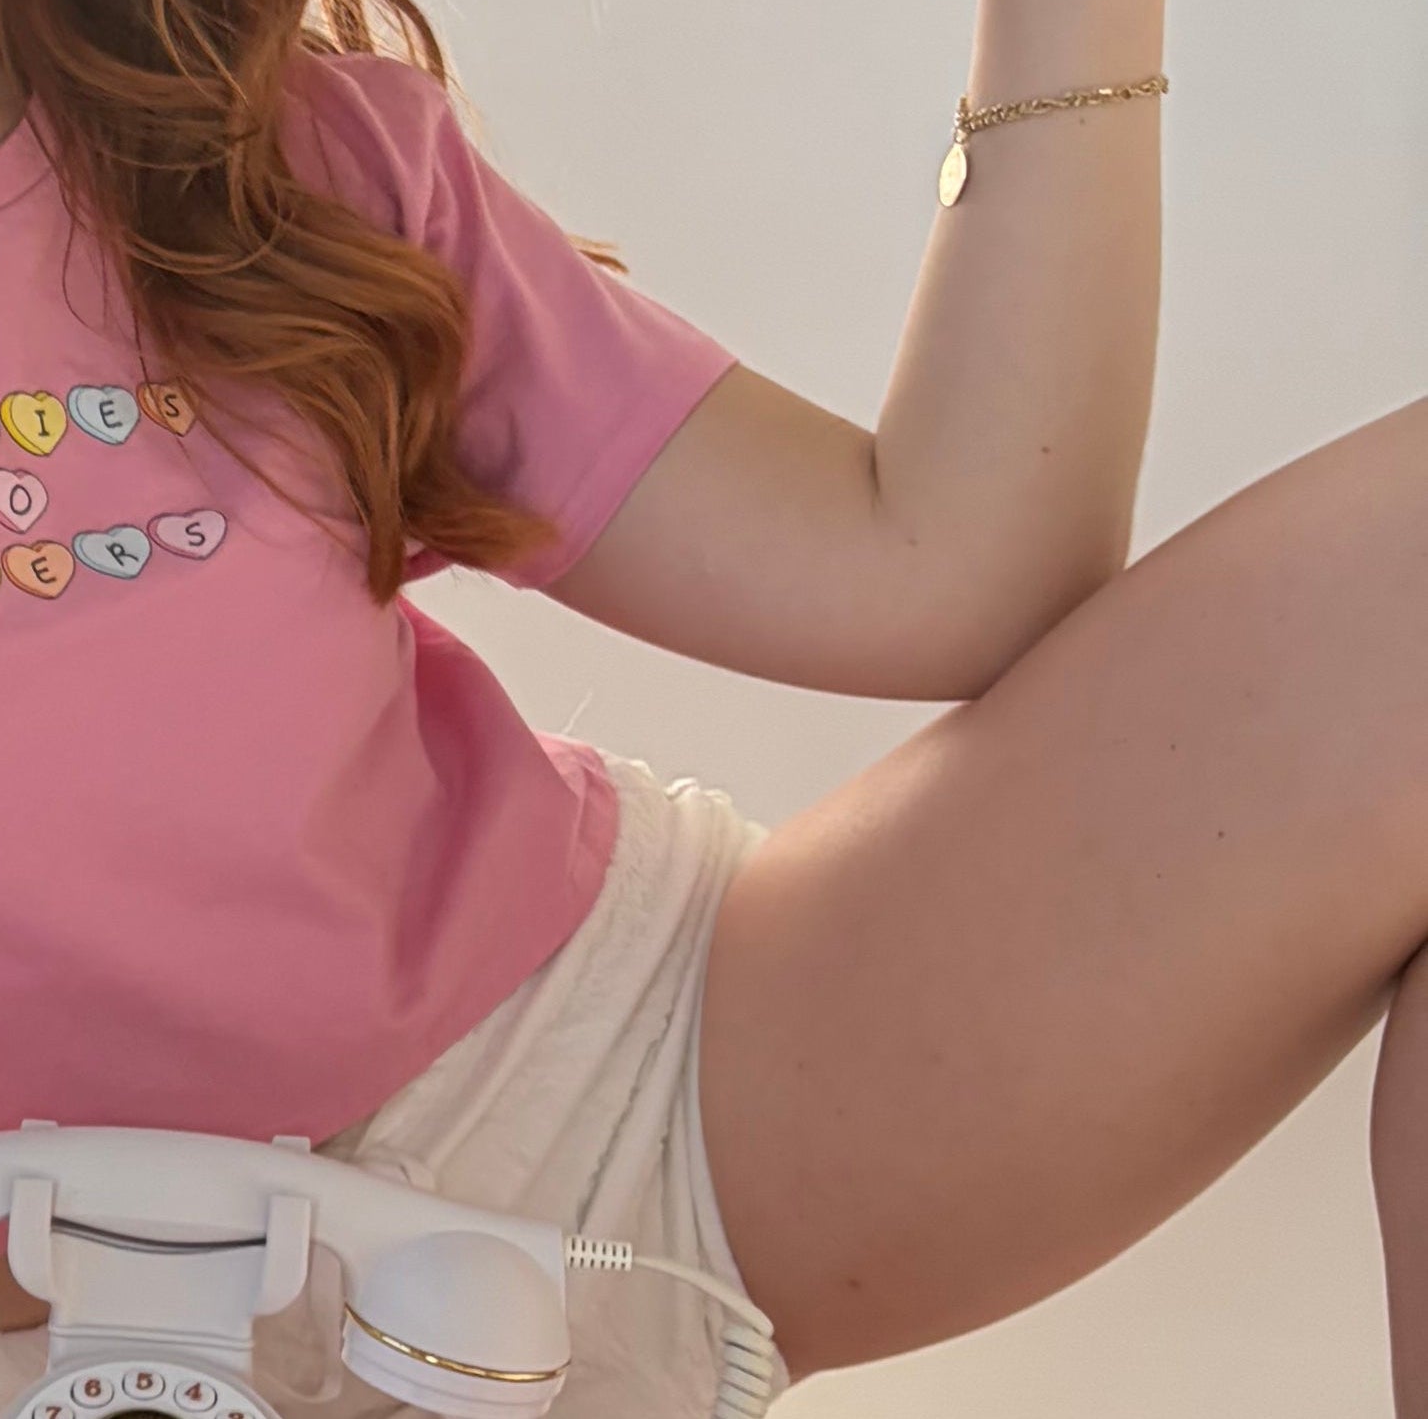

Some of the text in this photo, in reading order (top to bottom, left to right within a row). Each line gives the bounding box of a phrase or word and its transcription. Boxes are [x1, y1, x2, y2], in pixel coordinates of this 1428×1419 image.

[84, 1379, 101, 1397] 6
[136, 1372, 153, 1390] 5
[185, 1382, 202, 1401] 4
